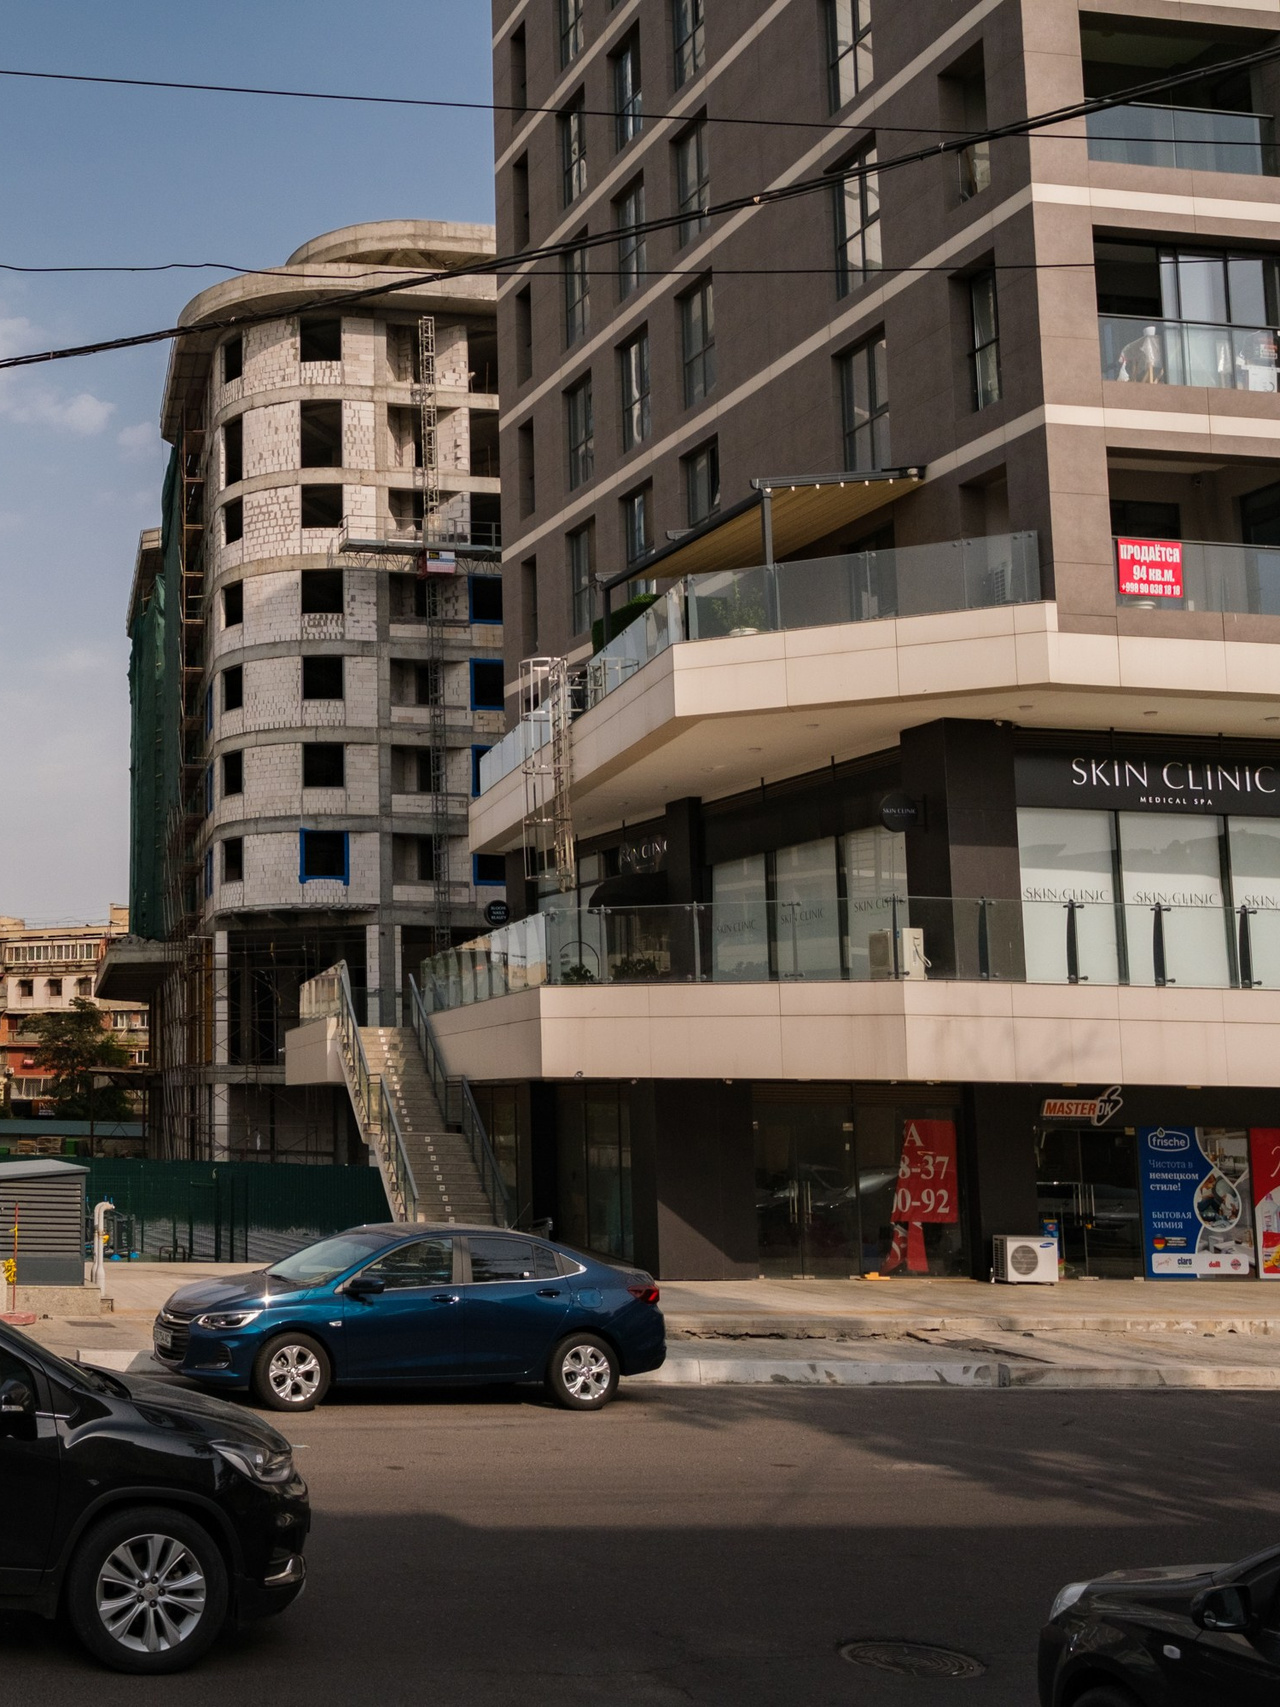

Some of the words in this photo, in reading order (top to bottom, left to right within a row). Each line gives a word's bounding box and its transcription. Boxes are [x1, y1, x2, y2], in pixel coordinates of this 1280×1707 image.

[1120, 544, 1180, 563] ПРОДАЁТСЯ
[1133, 565, 1147, 580] 94
[1121, 582, 1139, 593] +998
[1140, 583, 1149, 594] 90
[1164, 585, 1172, 595] 18
[1173, 585, 1180, 596] 18
[1071, 757, 1149, 787] SKIN
[1162, 762, 1276, 793] CLINIC
[1140, 796, 1187, 805] MEDICAL
[1024, 887, 1057, 900] SKIN
[1062, 888, 1110, 902] CLINIC
[1136, 891, 1168, 904] SKIN
[1172, 892, 1219, 906] CLINIC
[1244, 894, 1276, 908] SKIN
[854, 900, 873, 913] SKIN
[800, 908, 825, 922] CLINIC
[1152, 1137, 1186, 1147] frische
[1148, 1159, 1186, 1169] Чистота
[1149, 1172, 1199, 1181] немецком
[1150, 1182, 1181, 1191] стиле!
[1152, 1211, 1192, 1219] БЫТОВАЯ
[1152, 1221, 1184, 1229] ХИМИЯ
